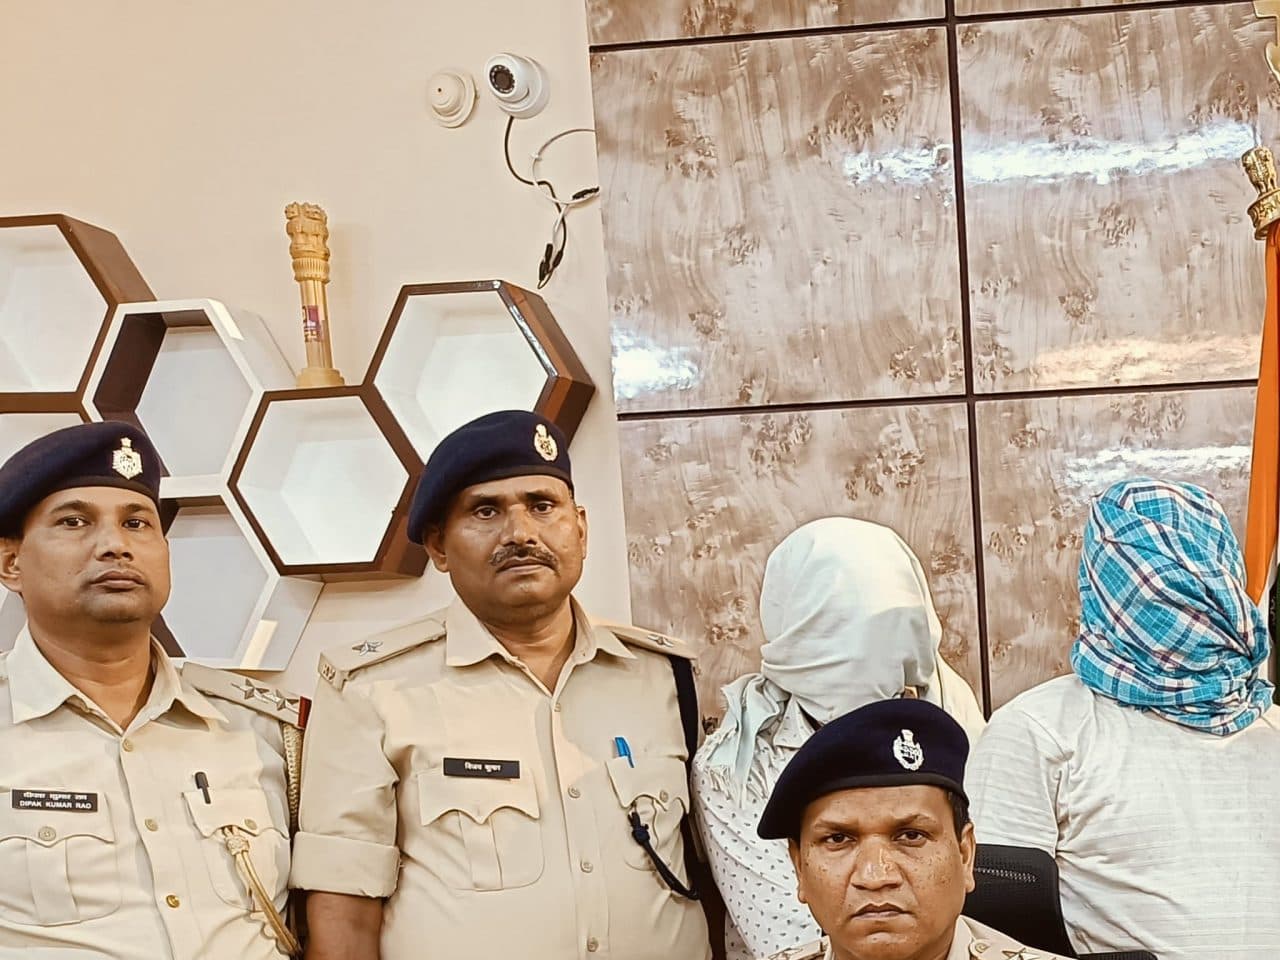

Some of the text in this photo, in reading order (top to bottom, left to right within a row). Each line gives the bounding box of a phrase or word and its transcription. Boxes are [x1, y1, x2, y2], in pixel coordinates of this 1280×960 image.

[19, 800, 92, 810] DIPAK KUMAR RAO
